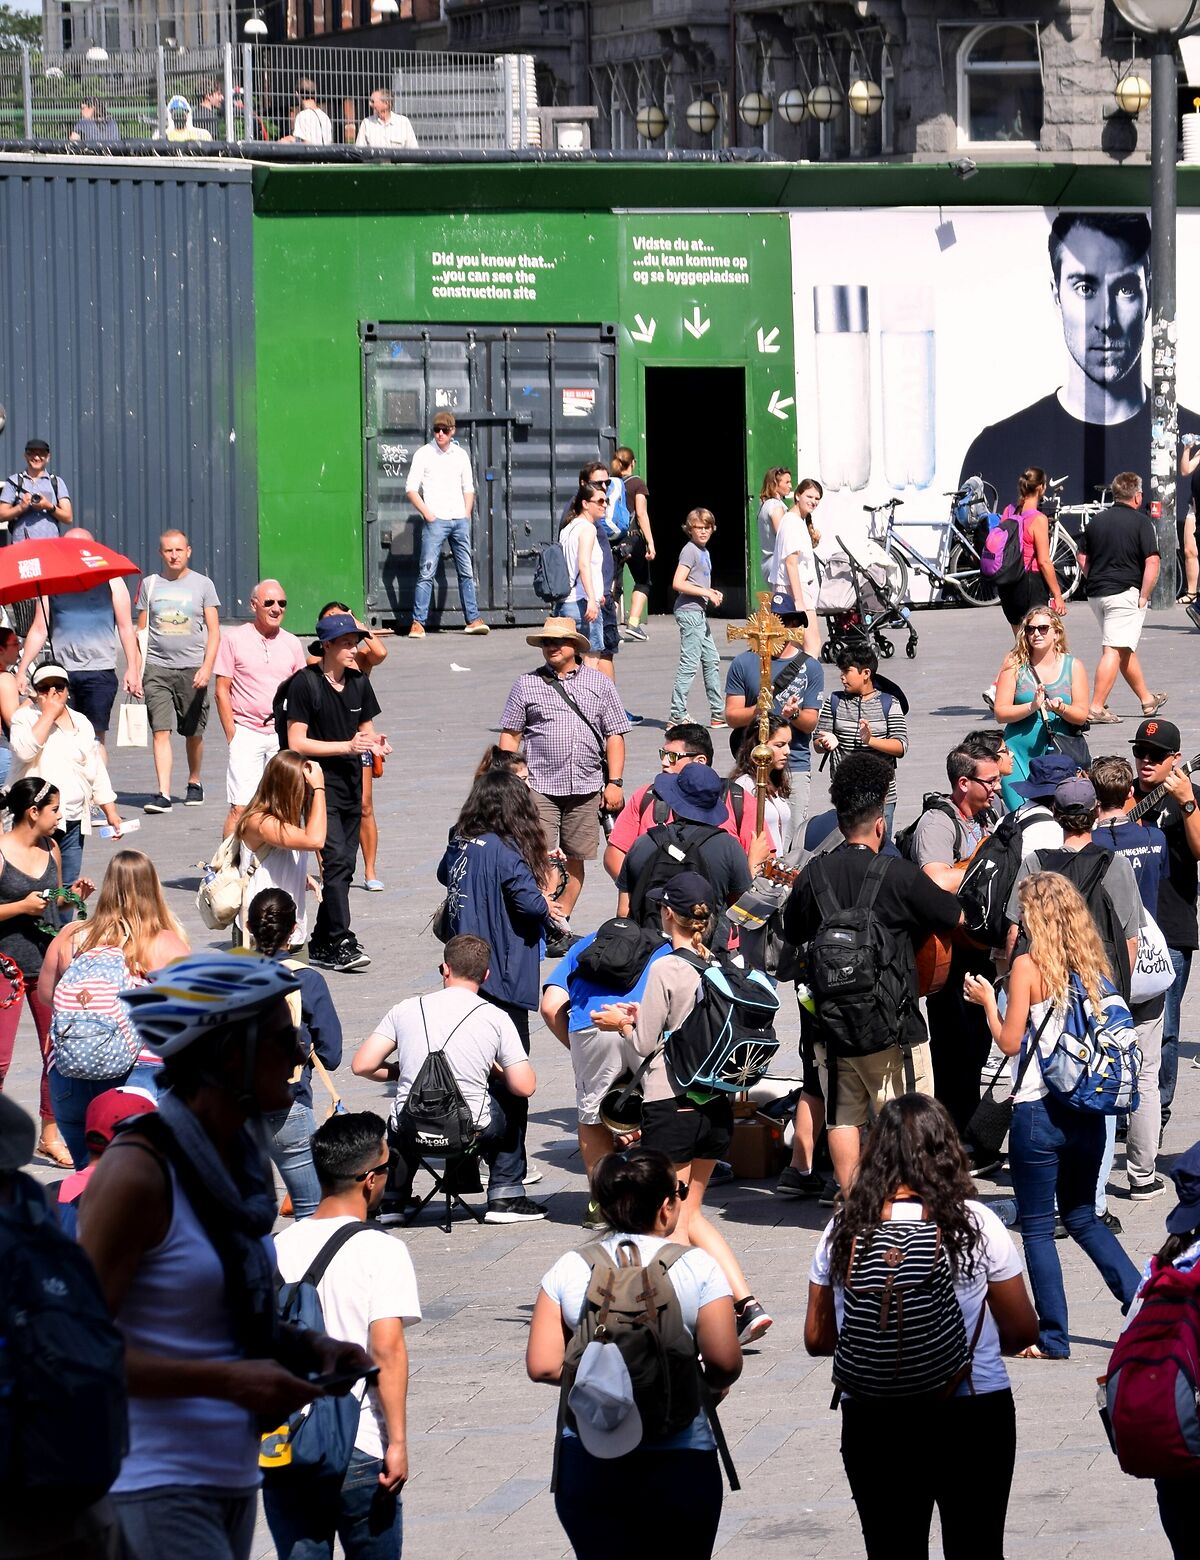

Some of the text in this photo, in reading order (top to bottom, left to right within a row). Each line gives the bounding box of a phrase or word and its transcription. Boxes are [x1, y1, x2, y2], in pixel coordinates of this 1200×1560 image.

[633, 236, 715, 251] Vidste du at...
[432, 252, 555, 269] Did you know that...
[633, 253, 748, 270] ...du kan komme op
[432, 270, 536, 284] ...you can see the
[633, 268, 750, 285] og se byggepladsen
[432, 285, 536, 300] construction site
[415, 1137, 449, 1146] IN-N-OUT
